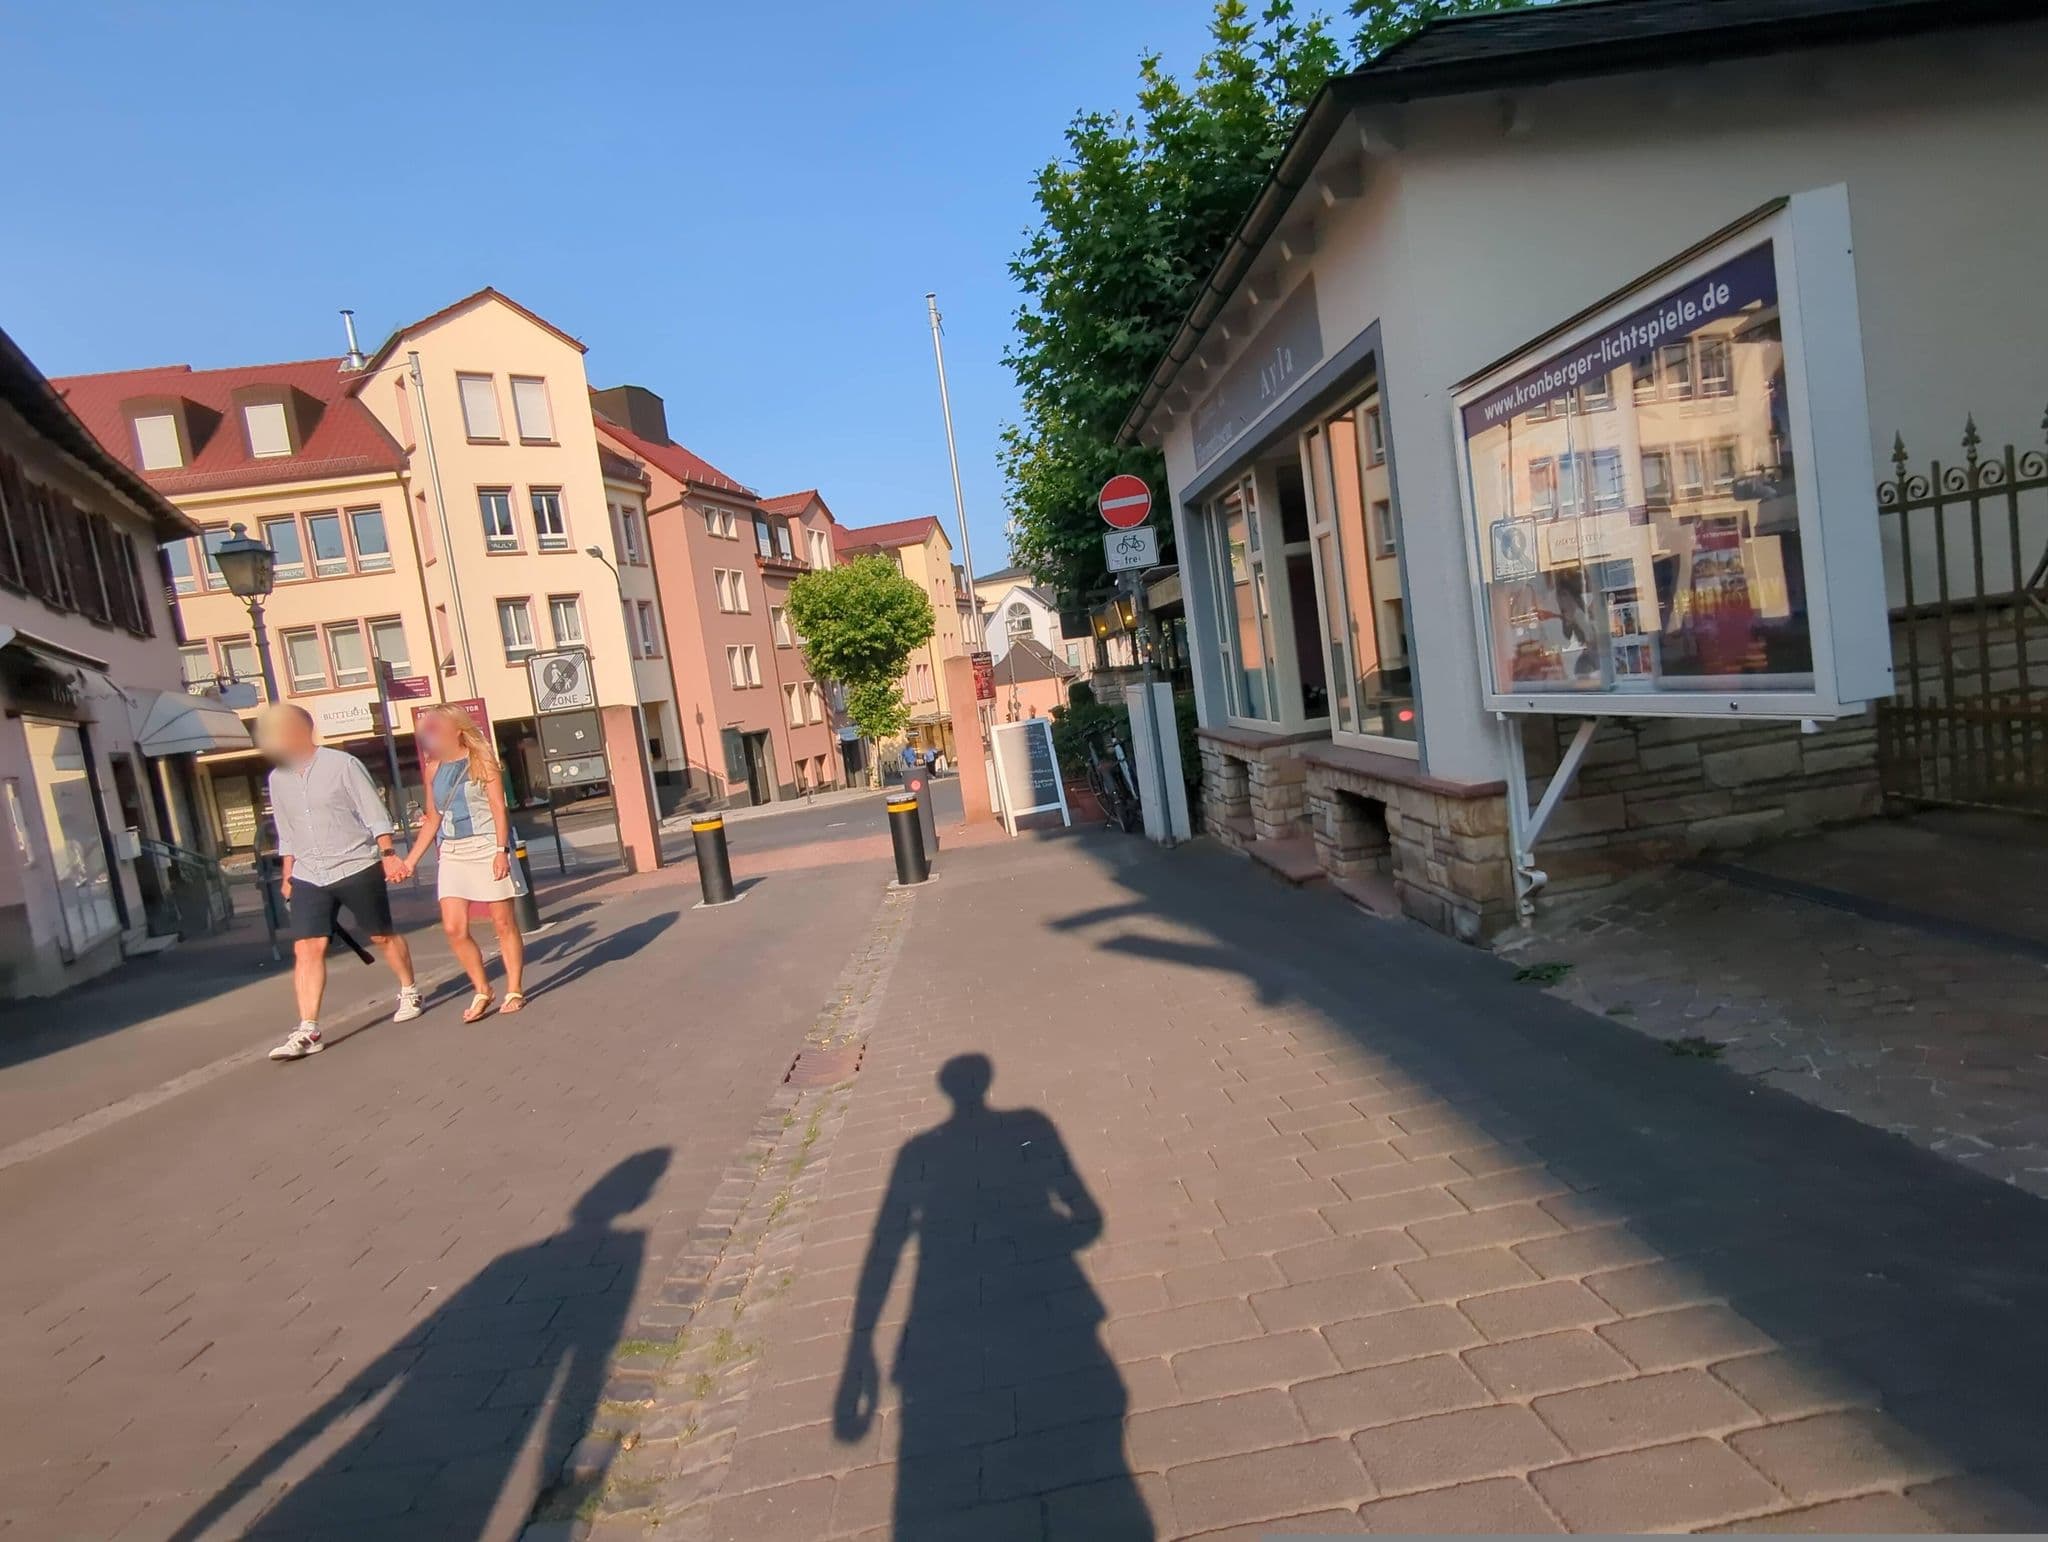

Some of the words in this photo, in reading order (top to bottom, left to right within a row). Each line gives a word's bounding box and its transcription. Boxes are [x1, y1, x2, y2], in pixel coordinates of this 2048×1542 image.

[1483, 281, 1731, 422] www.kronberger-lichtspiele.de
[1260, 346, 1293, 399] Ayla
[1125, 555, 1141, 565] frei
[552, 694, 579, 706] ZONE
